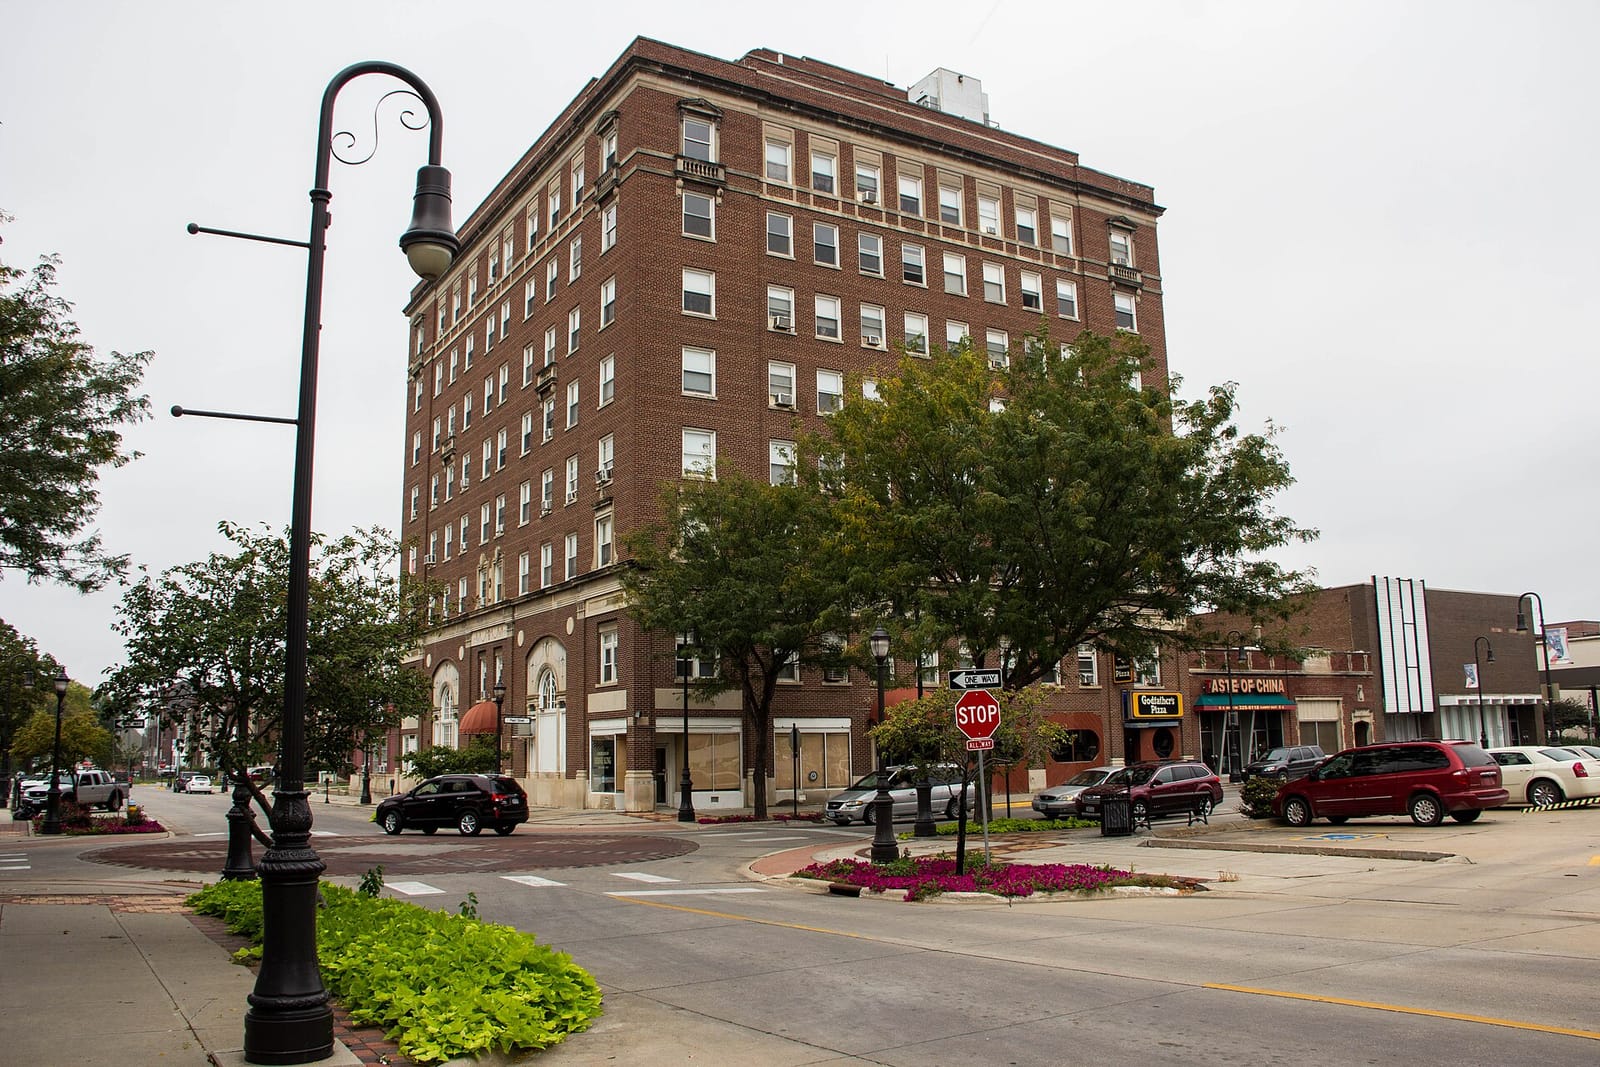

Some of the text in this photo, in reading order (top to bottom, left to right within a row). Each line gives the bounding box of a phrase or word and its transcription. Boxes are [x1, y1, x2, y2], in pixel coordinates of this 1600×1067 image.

[964, 674, 996, 684] ONE WAY
[1205, 678, 1285, 693] TASTE OF CHINA
[1141, 695, 1175, 705] Godfather's
[958, 704, 997, 725] STOP
[1150, 705, 1168, 714] Pizza
